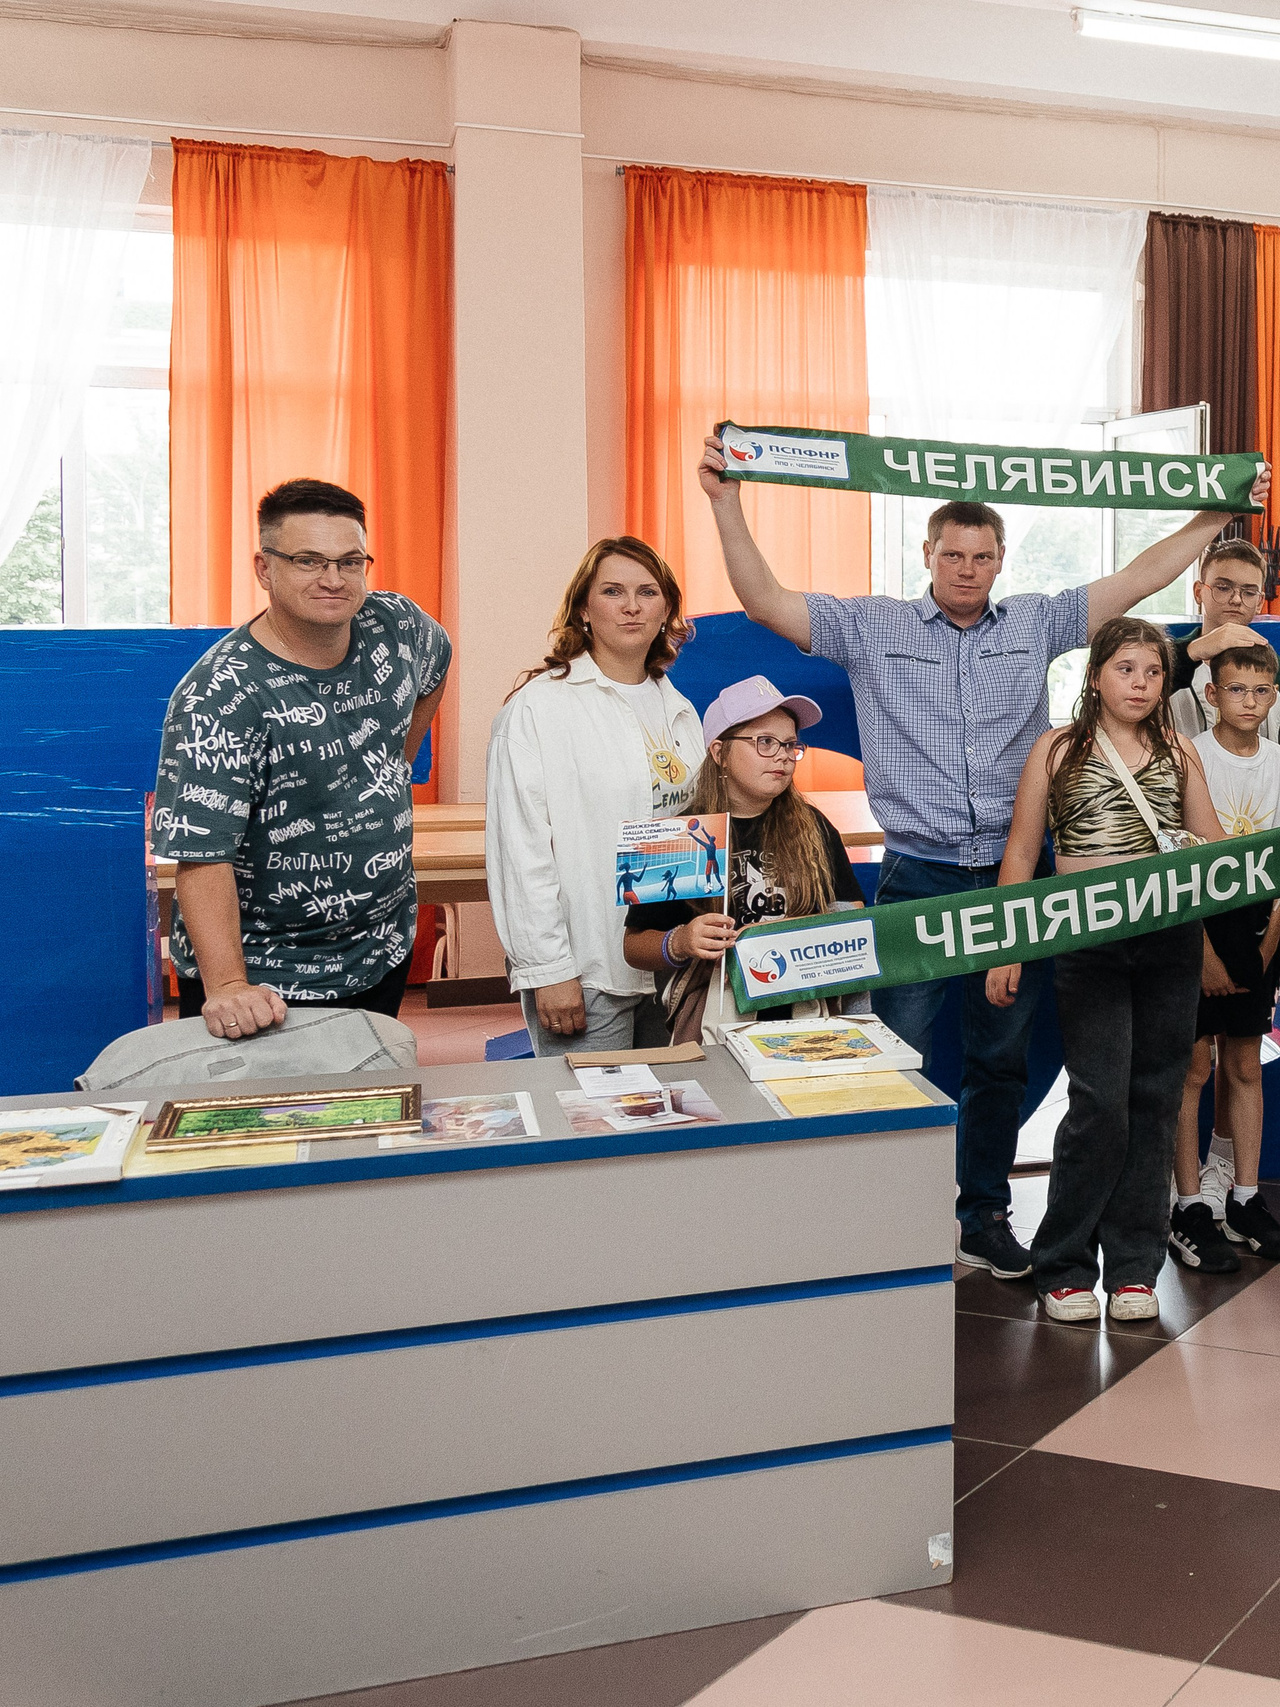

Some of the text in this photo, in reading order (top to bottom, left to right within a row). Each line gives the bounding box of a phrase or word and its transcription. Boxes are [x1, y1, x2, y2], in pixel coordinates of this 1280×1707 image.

[769, 444, 840, 460] ПСПФНР
[796, 462, 835, 472] ЧЕЛЯБИНСК
[883, 448, 1227, 500] ЧЕЛЯБИНСК
[317, 680, 352, 695] TO BE
[300, 740, 313, 753] IS
[322, 811, 342, 820] WHAT
[325, 821, 344, 830] DOES
[354, 807, 375, 820] MEAN
[325, 834, 338, 842] TO
[338, 829, 350, 838] BE
[349, 823, 363, 833] THE
[266, 852, 352, 874] BRUTALITY
[915, 846, 1276, 958] ЧЕЛЯБИНСК
[789, 937, 869, 962] ПСПФНР
[295, 963, 343, 974] YOUNG MAN
[800, 971, 817, 980] ППО
[823, 963, 865, 977] ЧЕЛЯБИНСК
